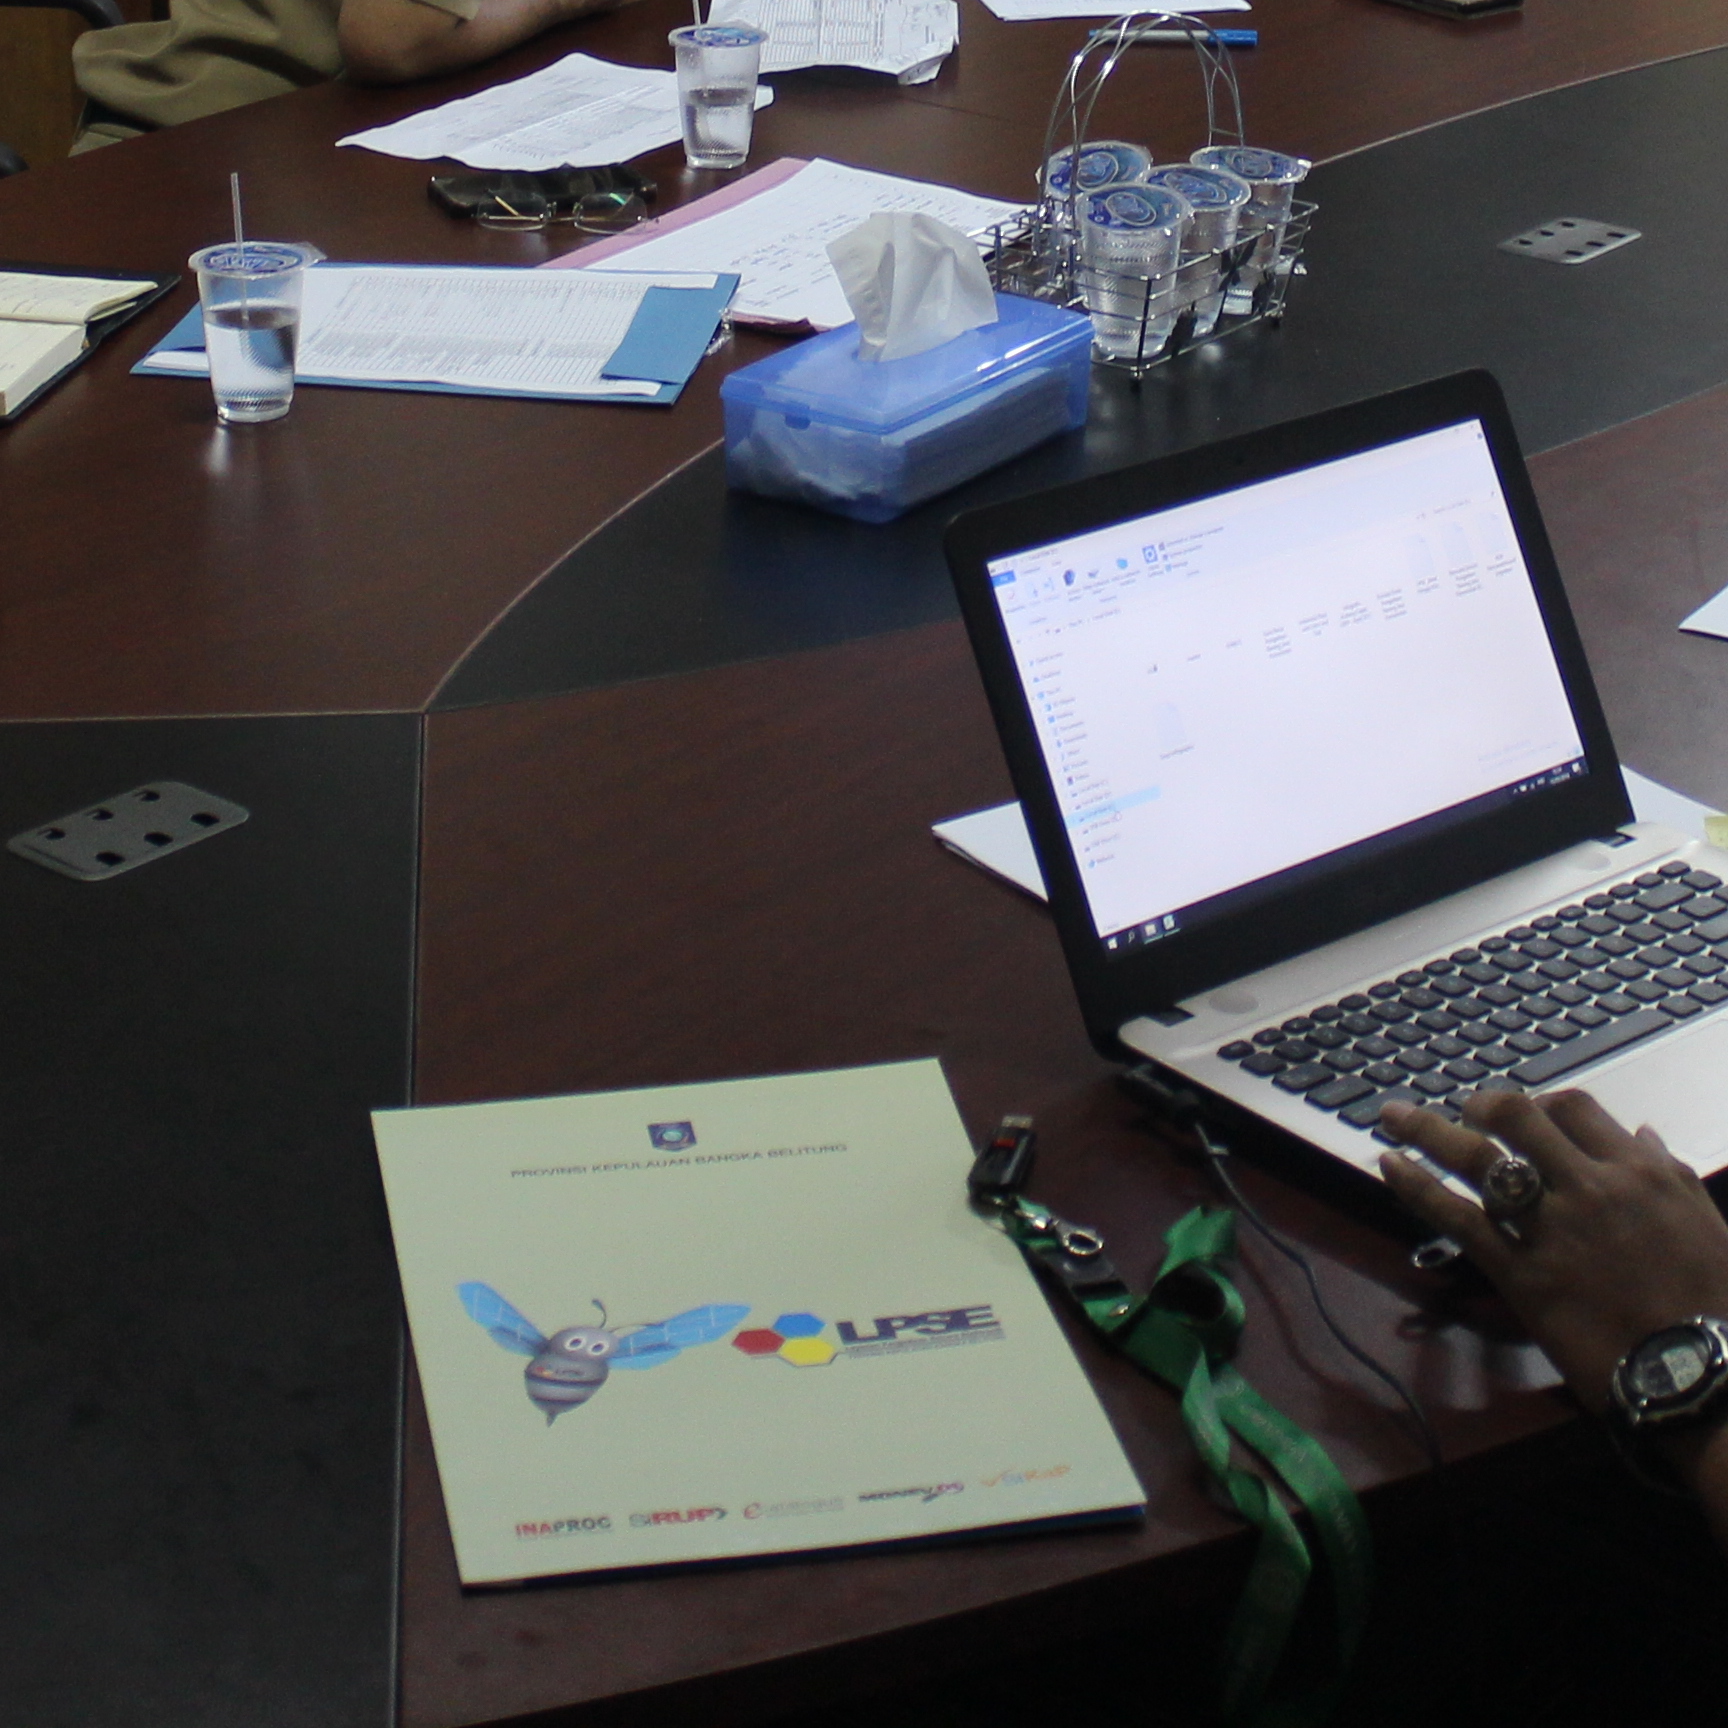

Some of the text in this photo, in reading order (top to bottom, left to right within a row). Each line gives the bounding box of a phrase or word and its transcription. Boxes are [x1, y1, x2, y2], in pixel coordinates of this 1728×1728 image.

[510, 1143, 848, 1178] PROVINSI KEPULAUAN BANGKA BELITUNG
[835, 1304, 1001, 1345] LPSE
[515, 1516, 613, 1538] INAPROC
